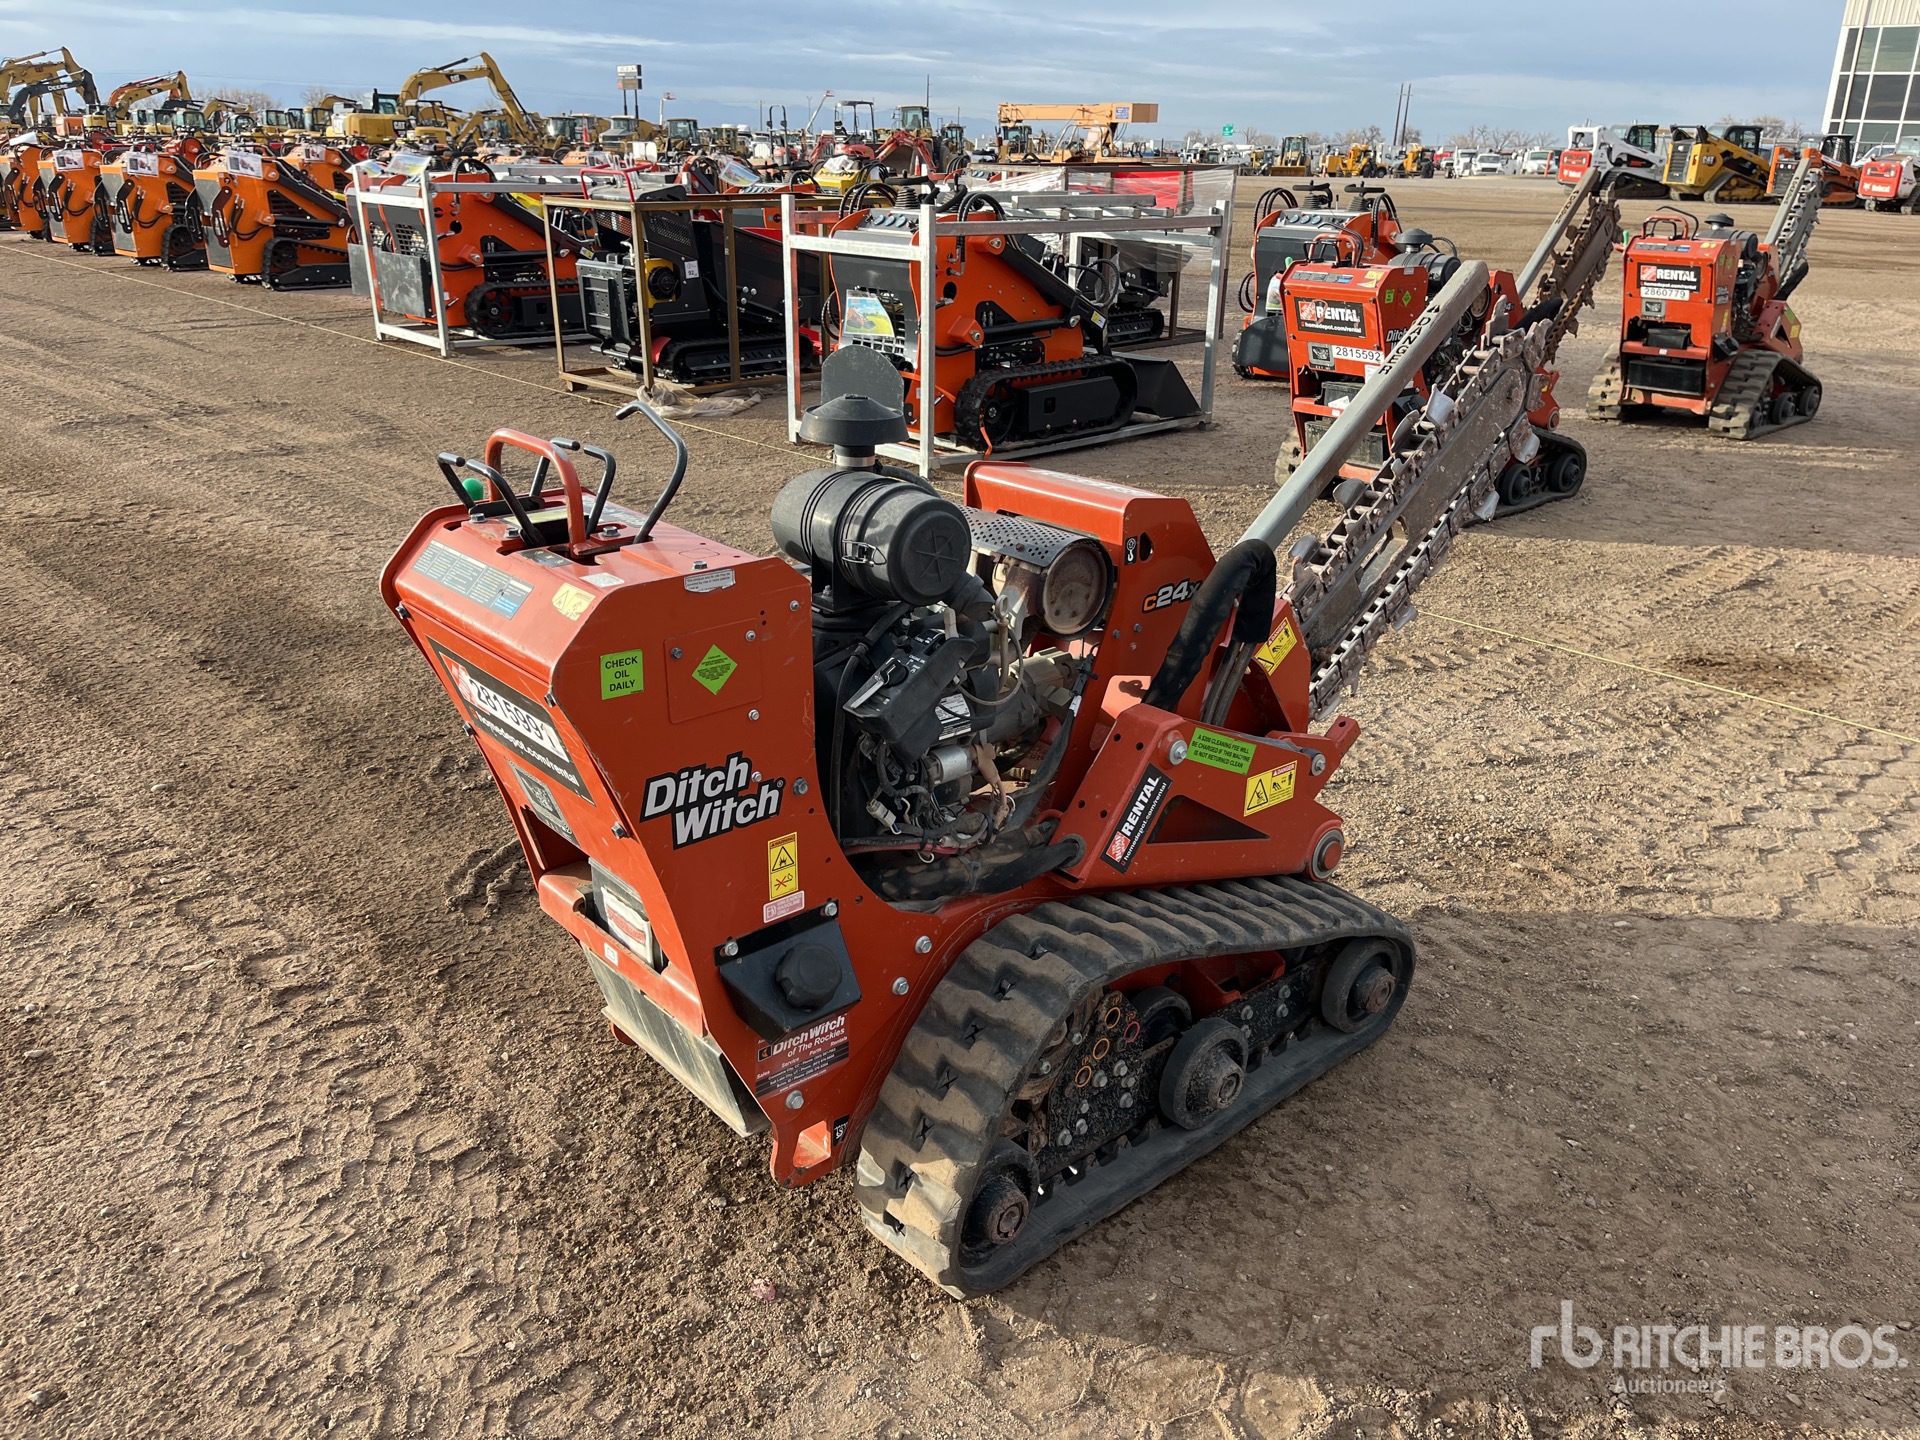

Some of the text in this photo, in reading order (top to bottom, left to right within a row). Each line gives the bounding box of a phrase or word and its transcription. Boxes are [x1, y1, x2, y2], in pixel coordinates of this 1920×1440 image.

[450, 74, 461, 82] CAT
[47, 83, 68, 91] DEERE
[394, 122, 406, 130] CAT
[1702, 156, 1714, 165] CAT
[1872, 184, 1890, 193] Bobcat
[1657, 269, 1697, 282] RENTAL
[1644, 288, 1686, 299] 2860779
[1316, 306, 1360, 322] RENTAL
[1378, 316, 1431, 374] DANGER
[1336, 347, 1381, 361] 2815592
[605, 656, 638, 669] CHECK
[614, 670, 630, 679] OIL
[610, 680, 636, 692] DAILY
[1198, 742, 1218, 754] CHARGED
[1229, 759, 1244, 768] CLEAN
[644, 756, 749, 818] Ditch
[1121, 776, 1160, 837] RENTAL
[1124, 782, 1167, 861] homedepot.com/rental
[772, 1032, 808, 1056] Ditch
[810, 1016, 845, 1039] Witch
[787, 1028, 845, 1057] of The Rockies
[756, 1071, 770, 1079] Sales
[781, 1057, 800, 1068] Service
[830, 1036, 848, 1046] Rentals
